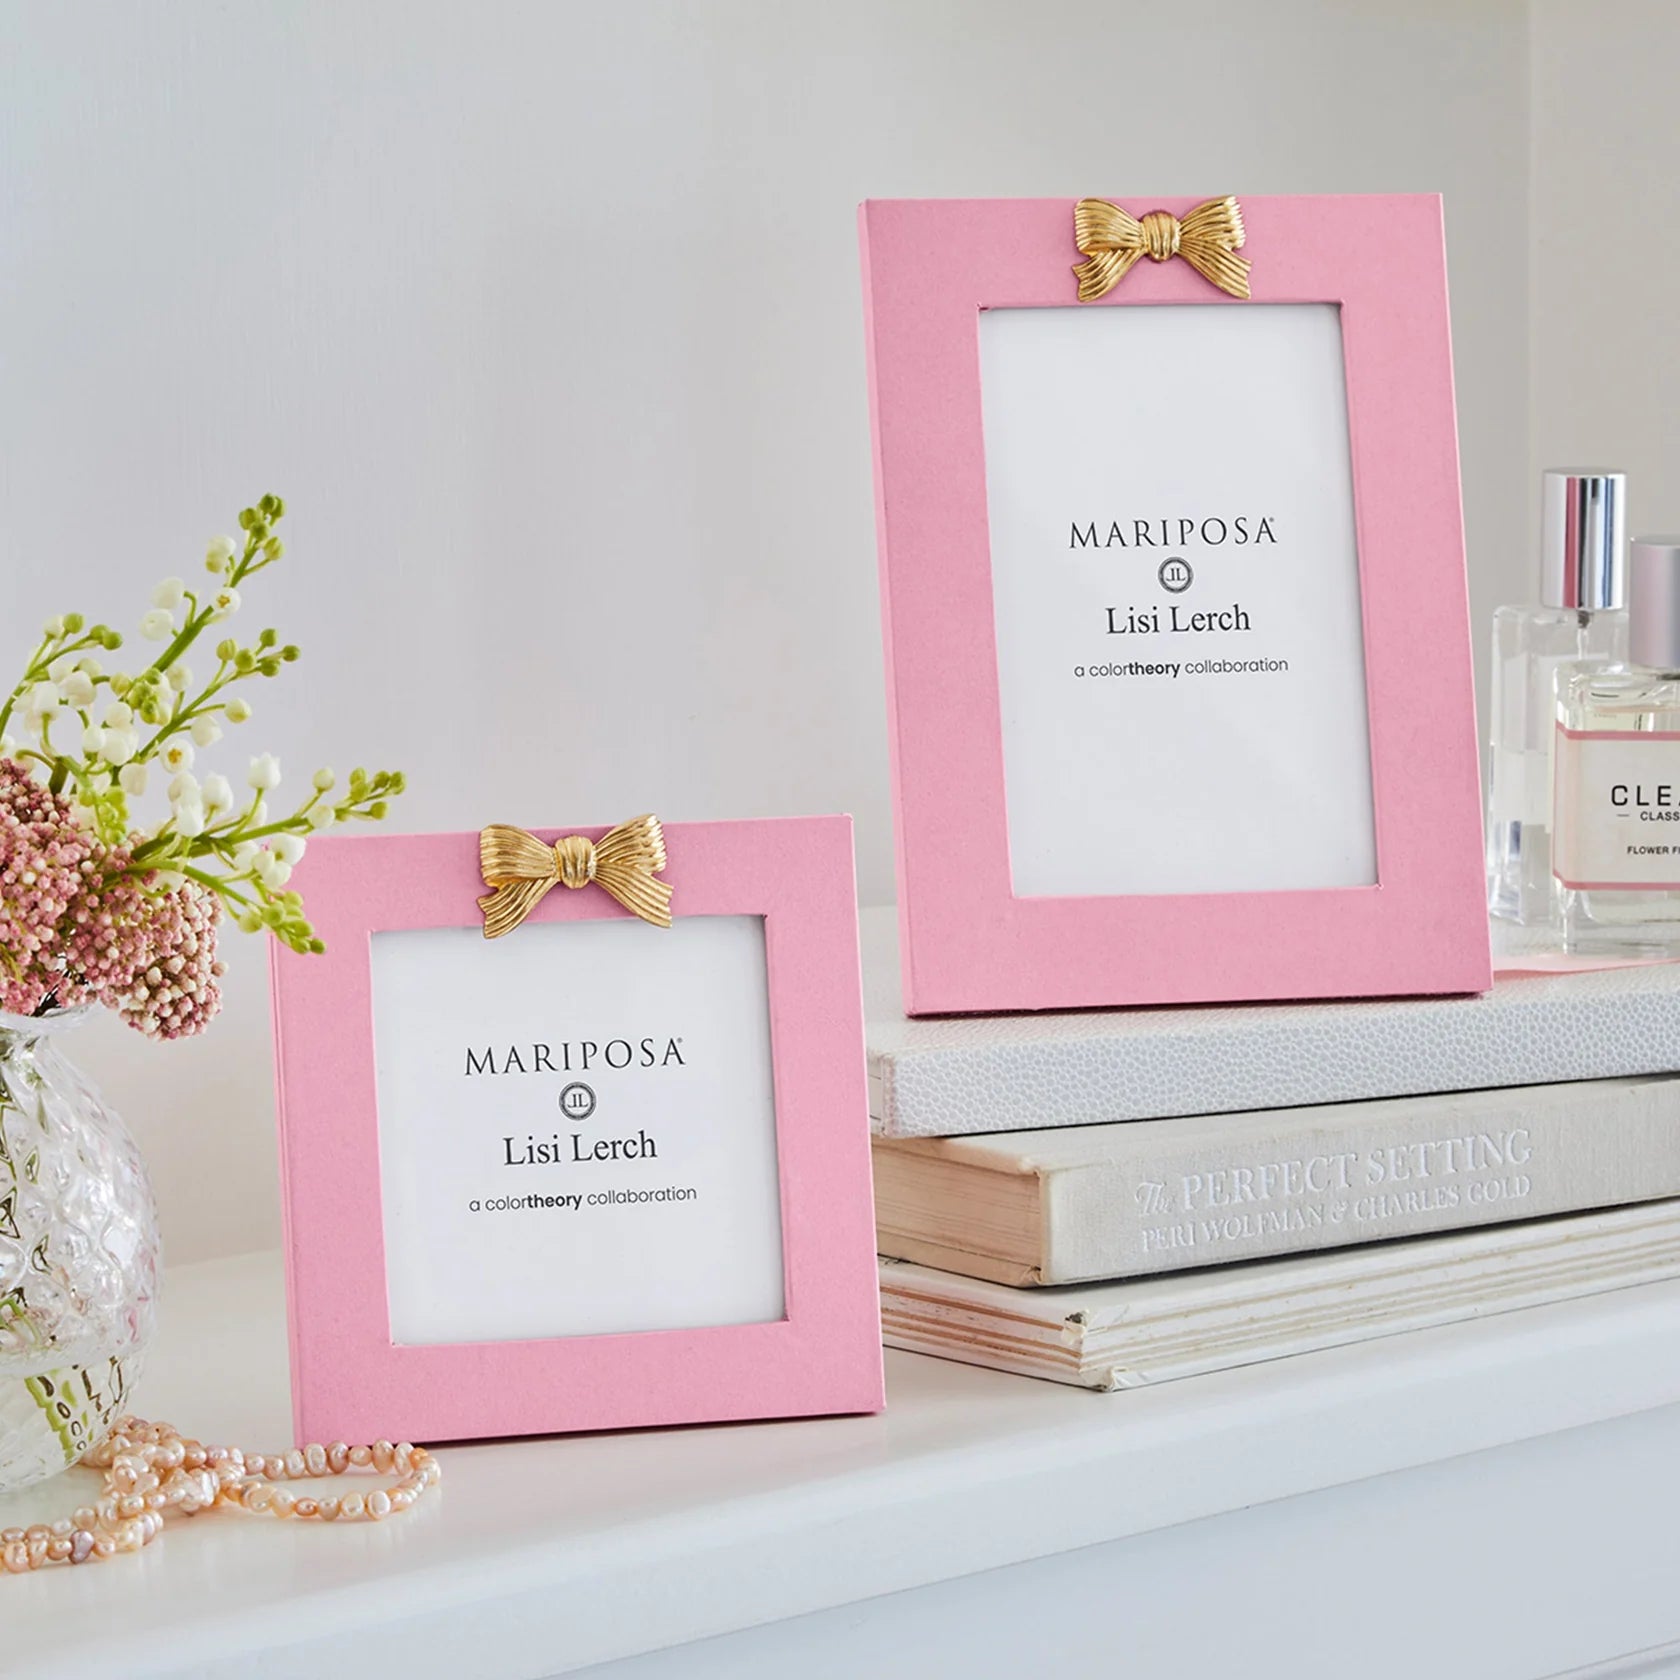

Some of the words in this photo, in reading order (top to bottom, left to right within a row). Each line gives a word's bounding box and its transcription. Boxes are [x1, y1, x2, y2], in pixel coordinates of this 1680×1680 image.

[1105, 605, 1161, 635] Lisi
[1168, 603, 1252, 633] Lerch
[1073, 665, 1085, 678] a
[1088, 661, 1181, 679] colortheory
[1184, 657, 1289, 675] collaboration
[1611, 784, 1680, 807] CLE
[1627, 845, 1670, 855] FLOWER
[502, 1133, 561, 1166] Lisi
[570, 1129, 658, 1162] Lerch
[1135, 1180, 1173, 1217] The
[1181, 1152, 1359, 1211] PERFECT
[1366, 1128, 1533, 1186] SETTING
[468, 1199, 481, 1213] a
[484, 1193, 583, 1212] colortheory
[586, 1186, 697, 1206] collaboration
[1141, 1221, 1196, 1253] PERI
[1202, 1201, 1325, 1241] WOLFMAN
[1331, 1200, 1349, 1224] &
[1354, 1184, 1462, 1222] CHARLES
[1468, 1175, 1532, 1206] GOLD
